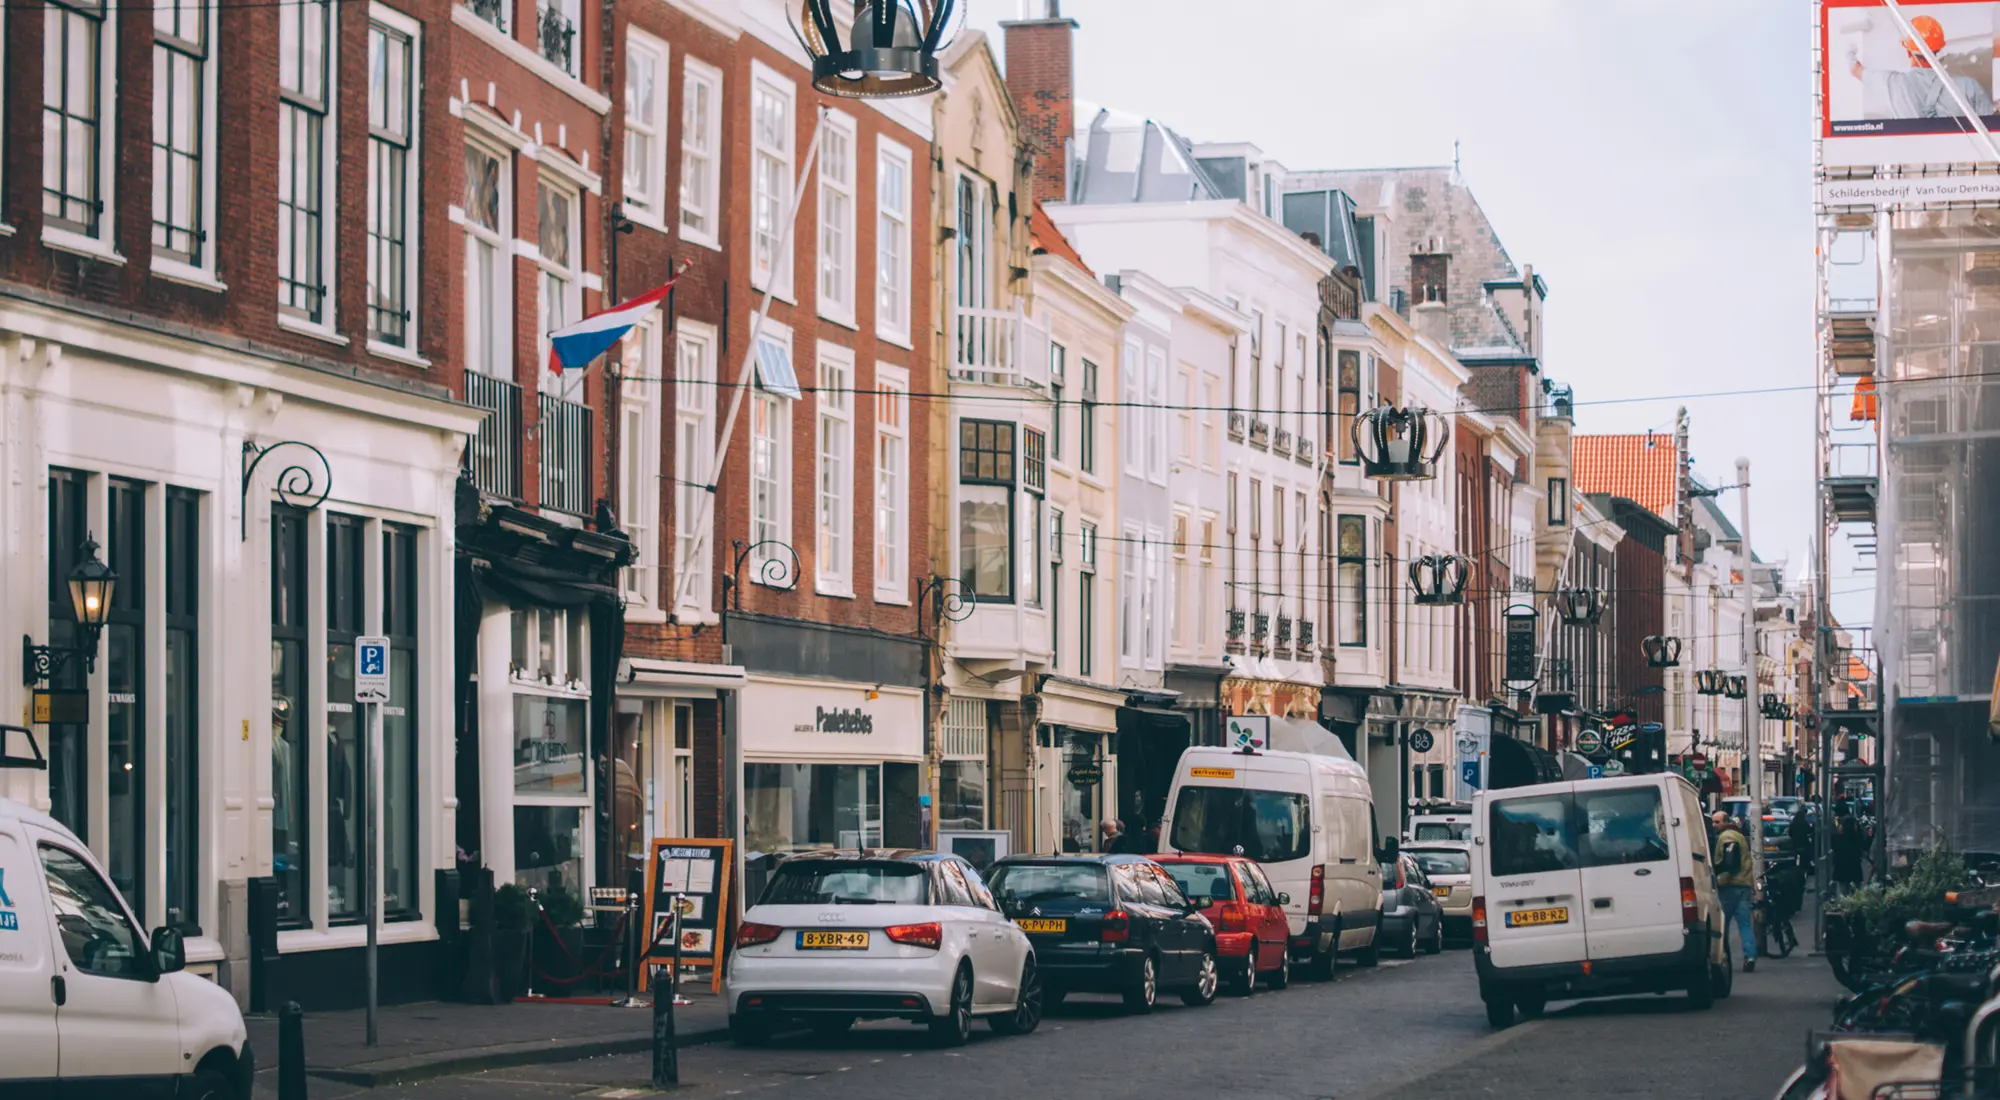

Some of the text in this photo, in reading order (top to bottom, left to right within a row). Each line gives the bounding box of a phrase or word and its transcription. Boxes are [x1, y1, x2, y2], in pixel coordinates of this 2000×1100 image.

[1829, 187, 1911, 199] Schildersbedrijf
[1916, 185, 1935, 195] Van
[1936, 185, 1958, 194] Tour
[1959, 184, 1980, 193] Den
[1514, 909, 1565, 923] 04-BB-RZ
[806, 933, 864, 945] 8-XBR-49
